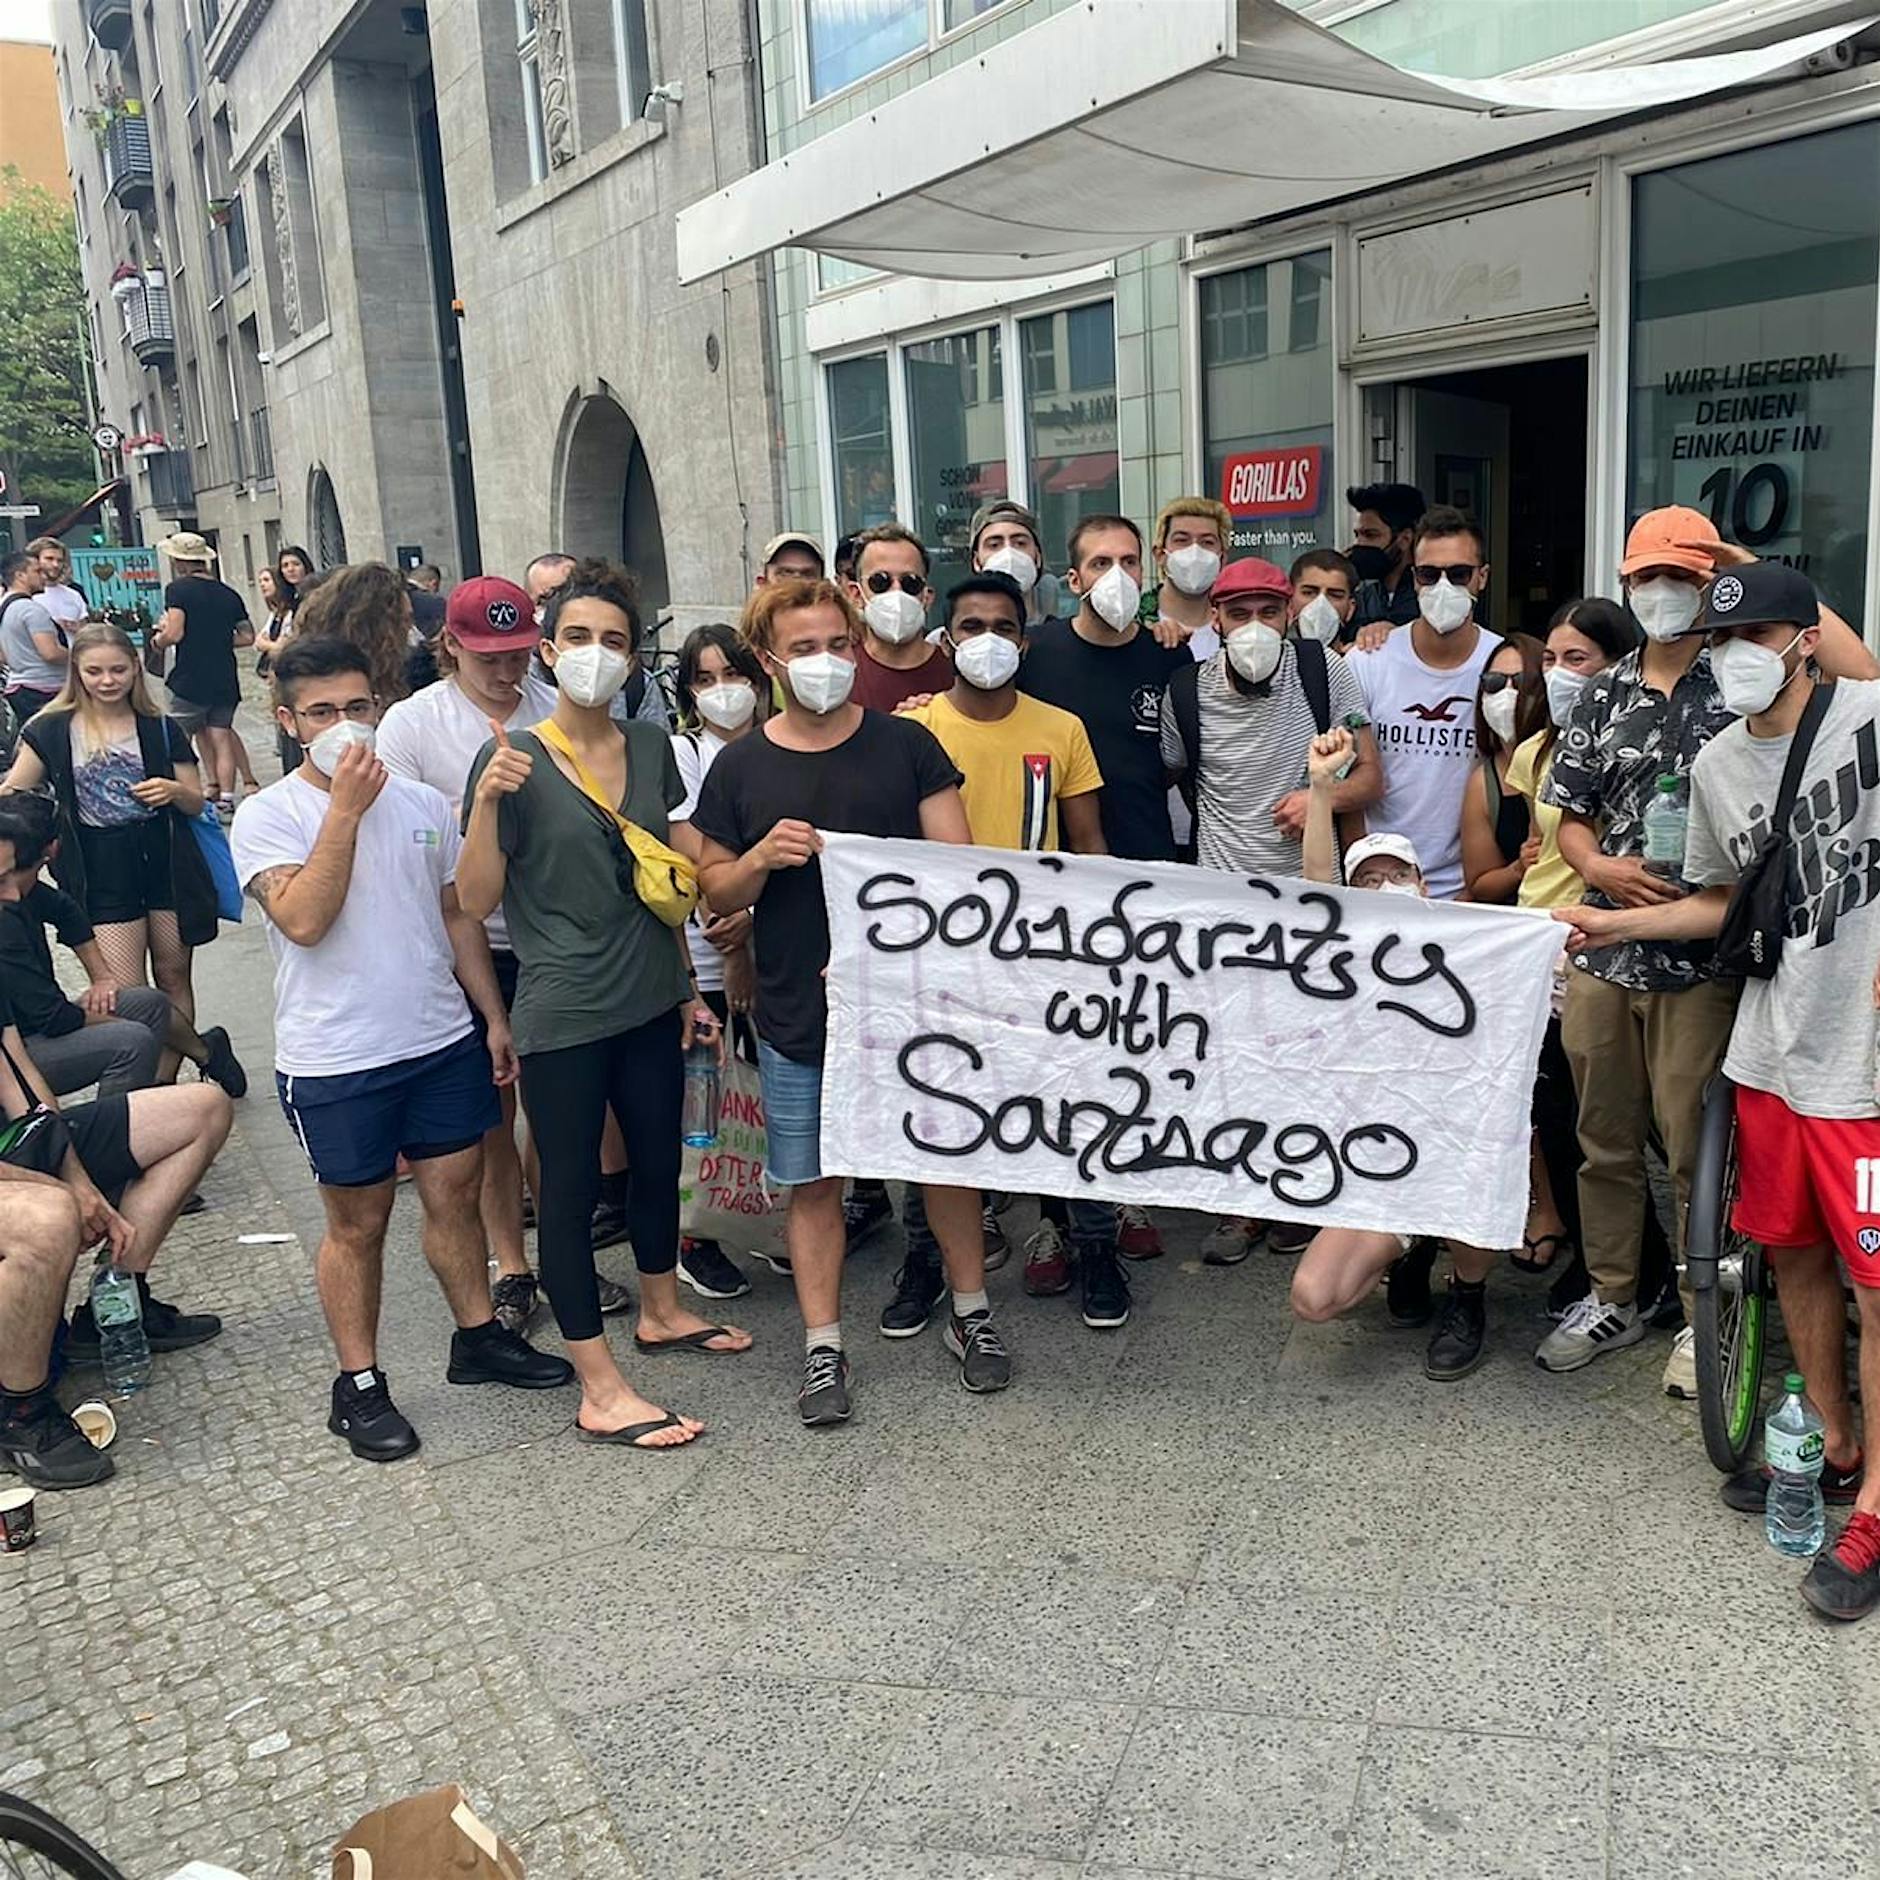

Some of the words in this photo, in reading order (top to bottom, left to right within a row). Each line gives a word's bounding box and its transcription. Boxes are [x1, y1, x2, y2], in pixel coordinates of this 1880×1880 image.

[1665, 367, 1715, 396] WIR
[1722, 352, 1838, 390] LIEFERN
[1695, 391, 1797, 426] DEINEN
[1671, 427, 1787, 460] EINKAUF
[1792, 425, 1822, 452] IN
[1229, 458, 1310, 505] GORILLAS
[1699, 463, 1789, 547] 10
[1228, 530, 1262, 547] Faster
[1264, 529, 1290, 546] than
[1292, 531, 1317, 548] you.
[1377, 723, 1476, 748] HOLLISTE
[1044, 966, 1210, 1061] with
[721, 1087, 765, 1128] ANK
[898, 1033, 1419, 1208] Santiago
